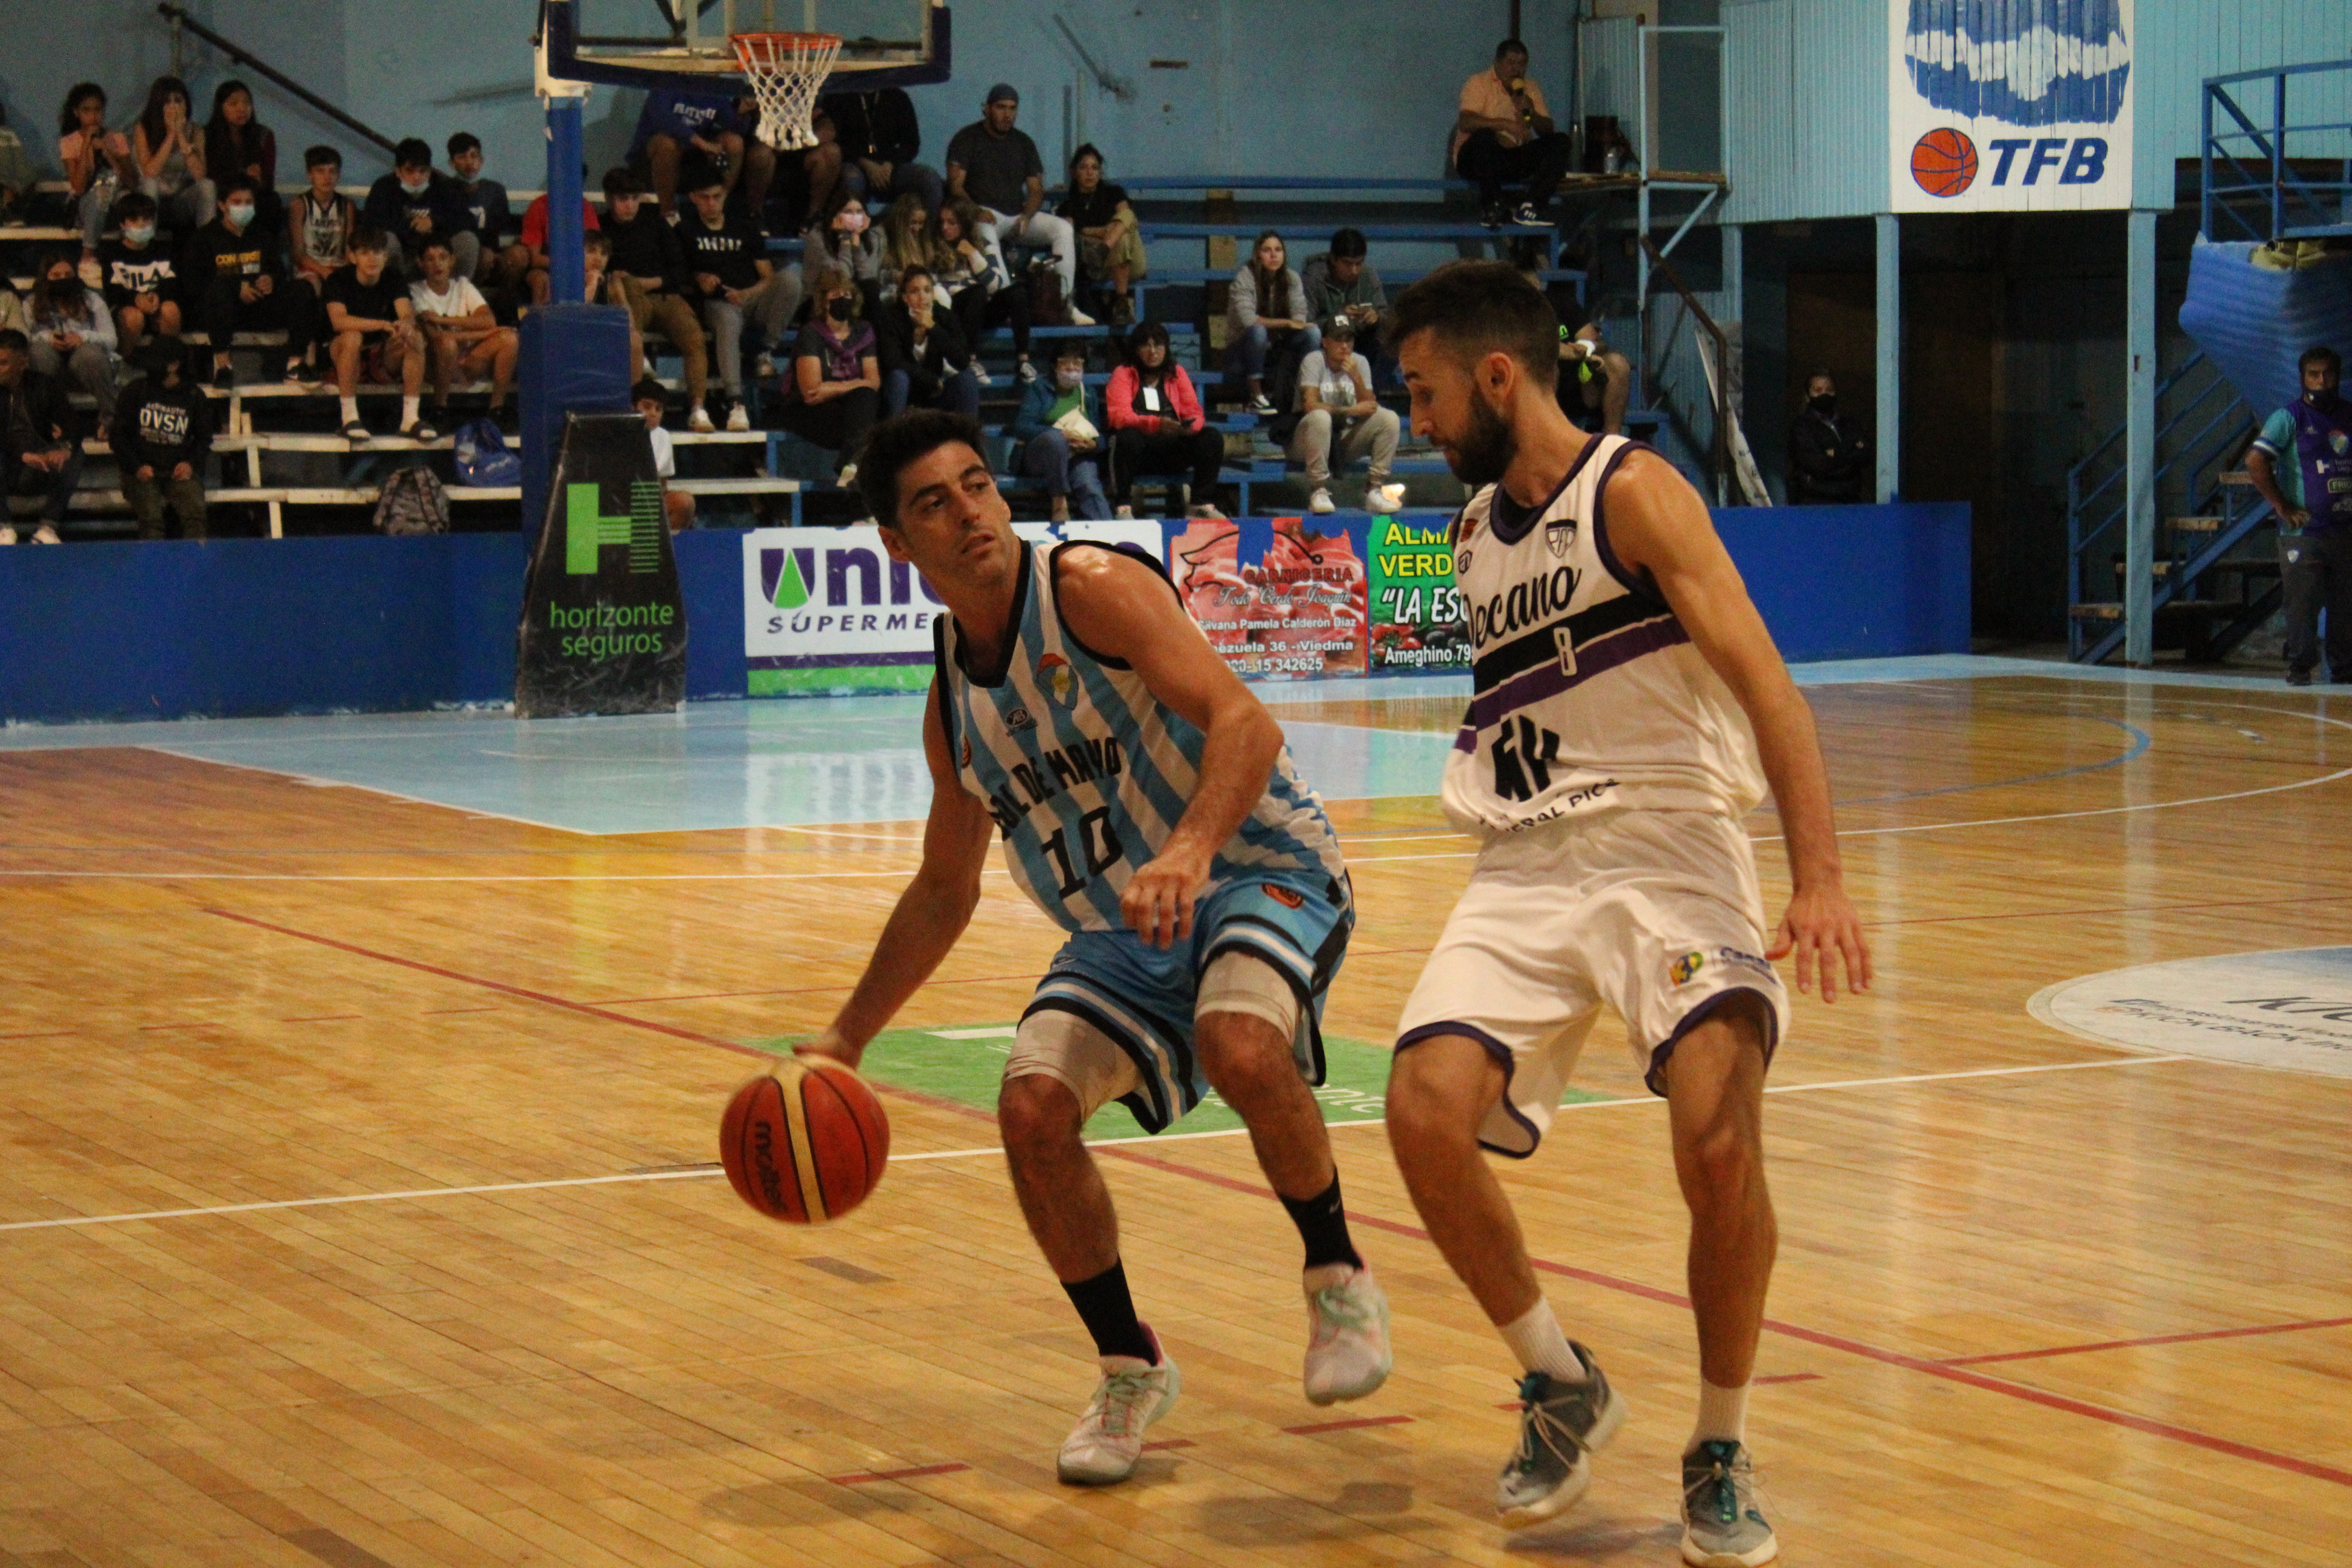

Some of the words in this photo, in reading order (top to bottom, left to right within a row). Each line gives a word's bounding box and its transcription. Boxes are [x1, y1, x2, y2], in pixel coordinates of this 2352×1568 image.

[1989, 137, 2108, 186] TFB
[550, 601, 674, 628] horizonte
[767, 613, 943, 634] SUPERME
[1240, 618, 1279, 629] Pamela
[1282, 617, 1330, 628] Calderón
[1334, 615, 1356, 626] Díaz
[561, 633, 662, 662] seguros
[1269, 641, 1287, 652] 36
[1299, 640, 1354, 651] Viedma
[1385, 644, 1452, 667] Ameghino
[1553, 627, 1577, 677] 8
[1256, 658, 1272, 671] 15
[1276, 657, 1323, 671] 342625
[1011, 757, 1056, 804] DE
[1044, 737, 1122, 790] MAYO
[1040, 806, 1124, 899] 10
